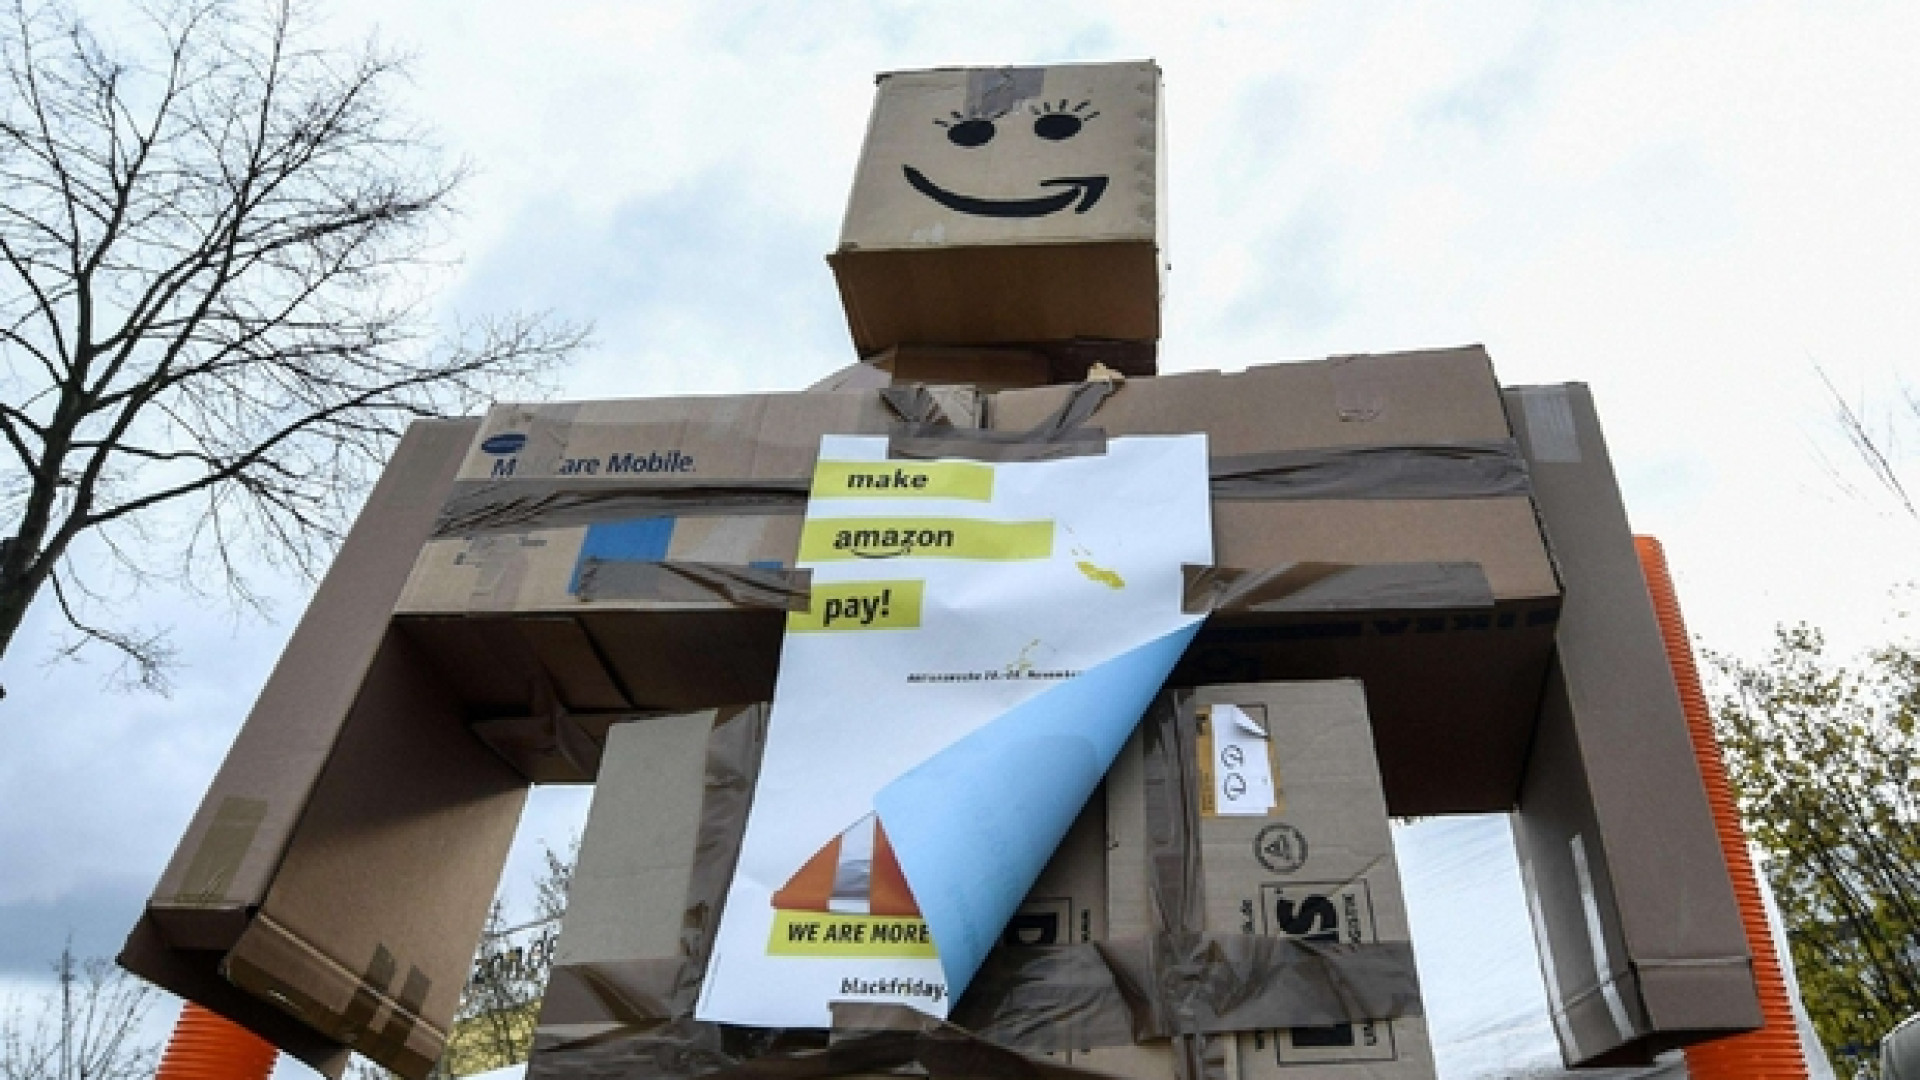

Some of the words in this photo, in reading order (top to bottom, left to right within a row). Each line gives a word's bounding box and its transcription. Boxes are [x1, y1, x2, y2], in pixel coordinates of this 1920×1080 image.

[846, 467, 930, 490] make
[832, 527, 955, 551] amazon
[823, 589, 891, 626] pay!
[788, 921, 820, 944] WE
[823, 921, 867, 944] ARE
[870, 921, 930, 944] MORE
